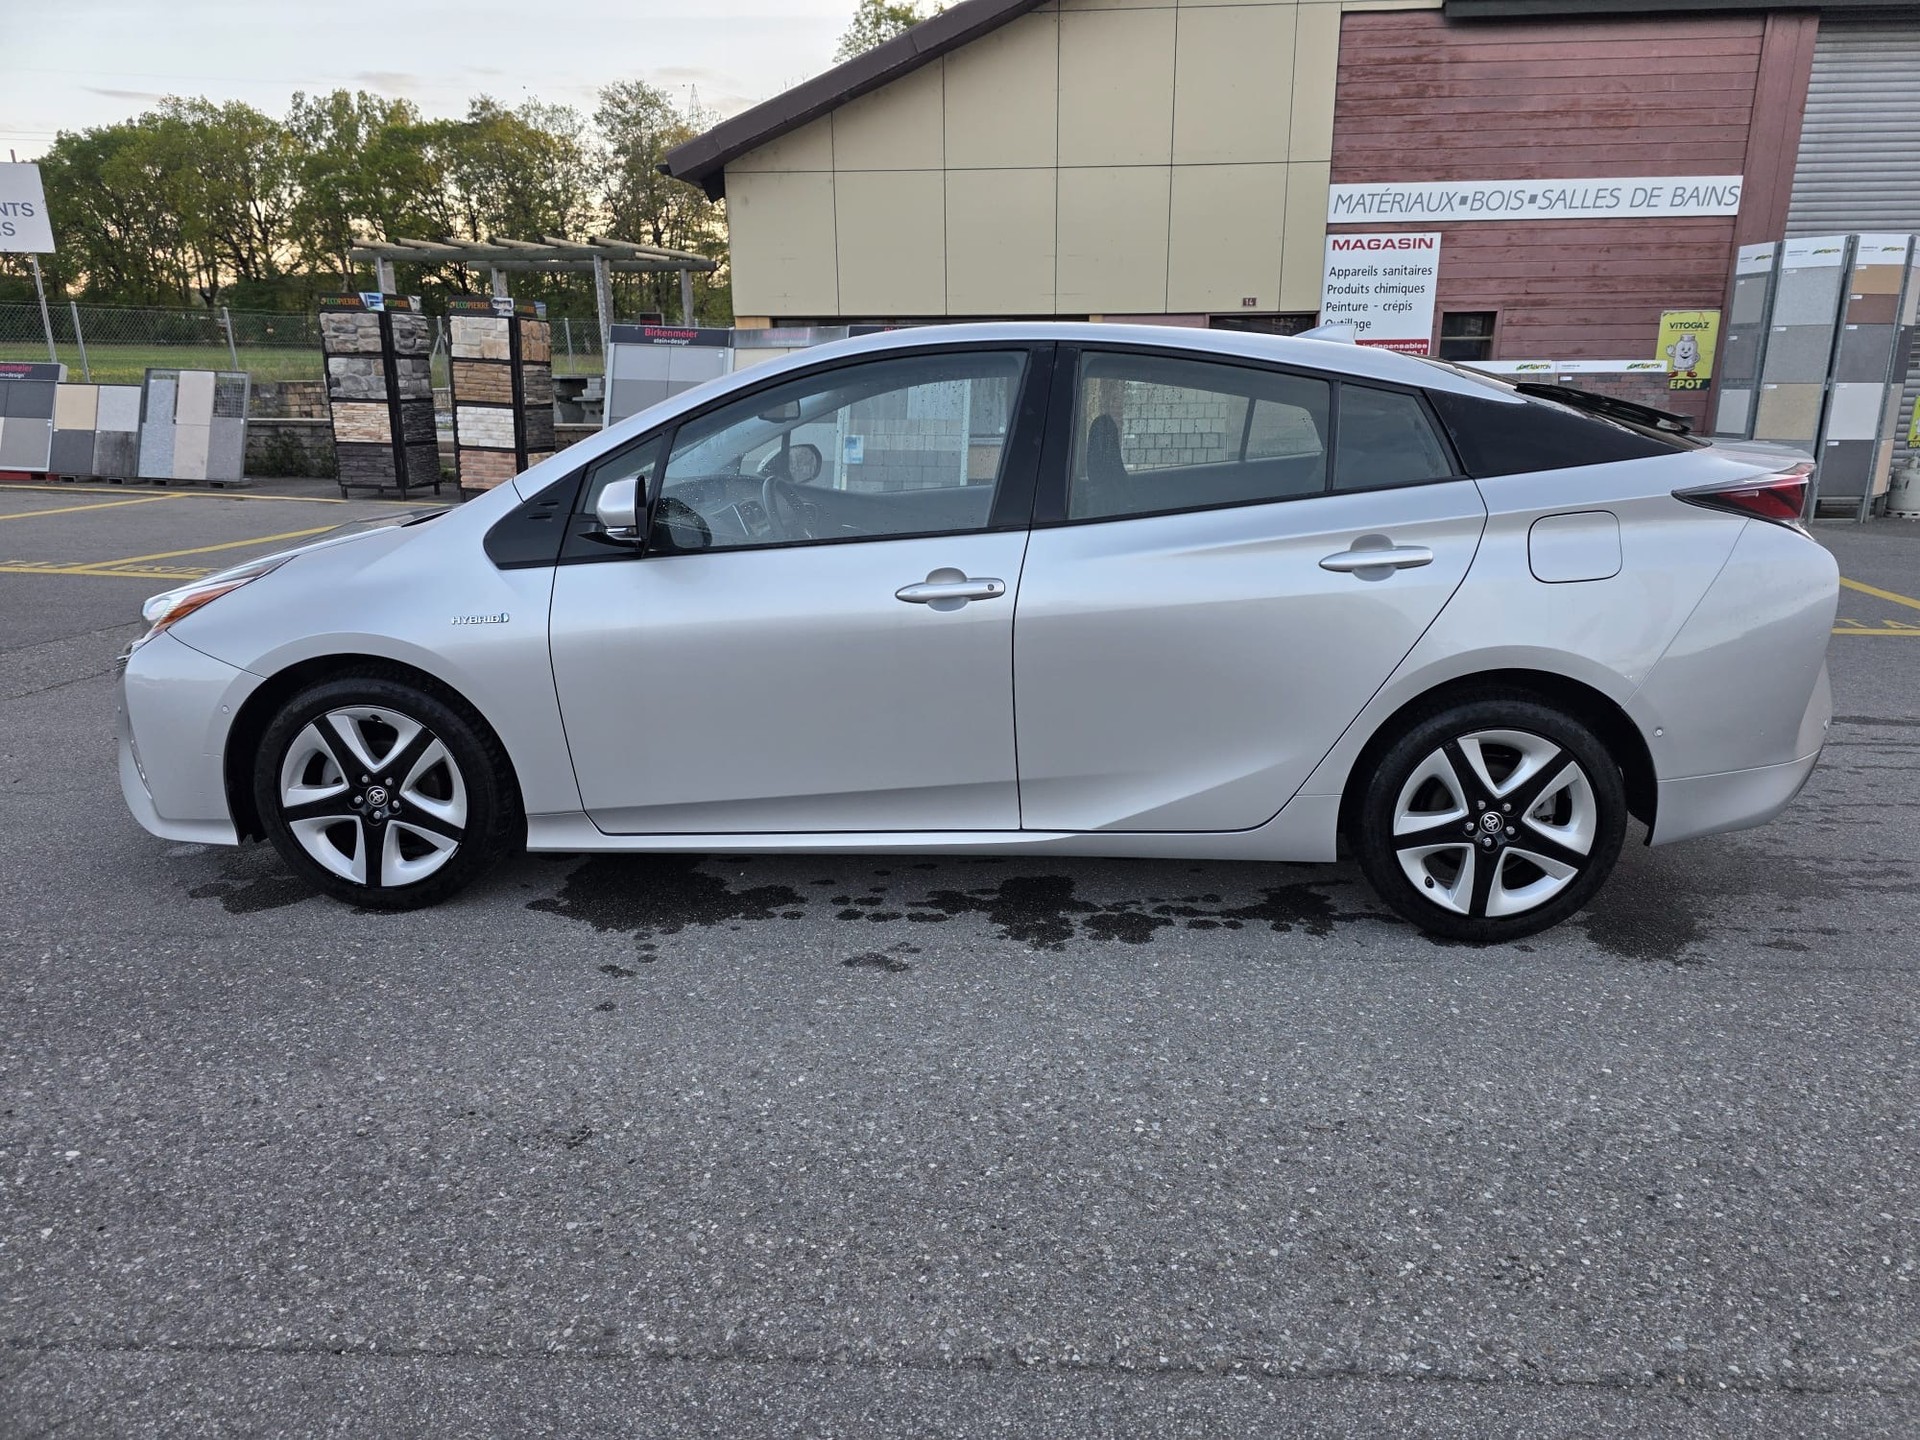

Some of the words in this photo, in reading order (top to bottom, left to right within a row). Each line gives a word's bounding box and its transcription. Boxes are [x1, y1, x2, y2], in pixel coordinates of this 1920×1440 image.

[1333, 187, 1459, 214] MATÉRIAUX
[1469, 190, 1526, 212] BOIS
[1537, 187, 1622, 210] SALLES
[1629, 187, 1664, 208] DE
[1669, 185, 1741, 207] BAINS
[1332, 238, 1434, 251] MAGASIN
[1328, 265, 1378, 280] Appareils
[1382, 264, 1433, 276] sanitaires
[1327, 283, 1370, 295] Produits
[1374, 282, 1426, 296] chimiques
[1325, 301, 1369, 312] Peinture
[1382, 300, 1413, 314] crépis
[644, 327, 698, 338] Birkenmeier
[451, 613, 501, 625] HYBRID
